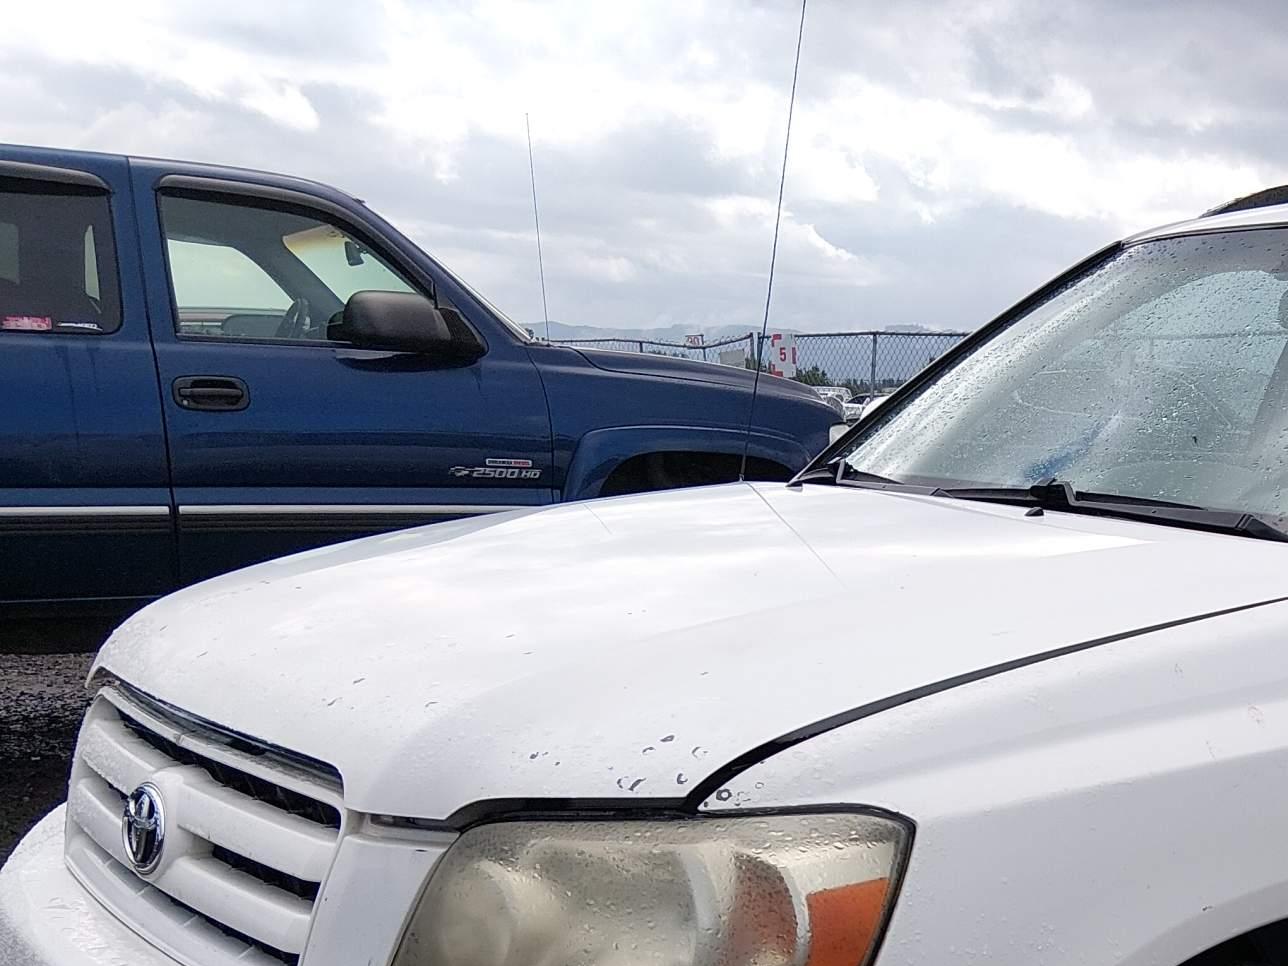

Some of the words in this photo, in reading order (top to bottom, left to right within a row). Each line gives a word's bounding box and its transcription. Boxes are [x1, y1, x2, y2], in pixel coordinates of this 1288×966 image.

[779, 347, 787, 361] 5
[472, 468, 518, 479] 2500
[521, 470, 542, 479] HD
